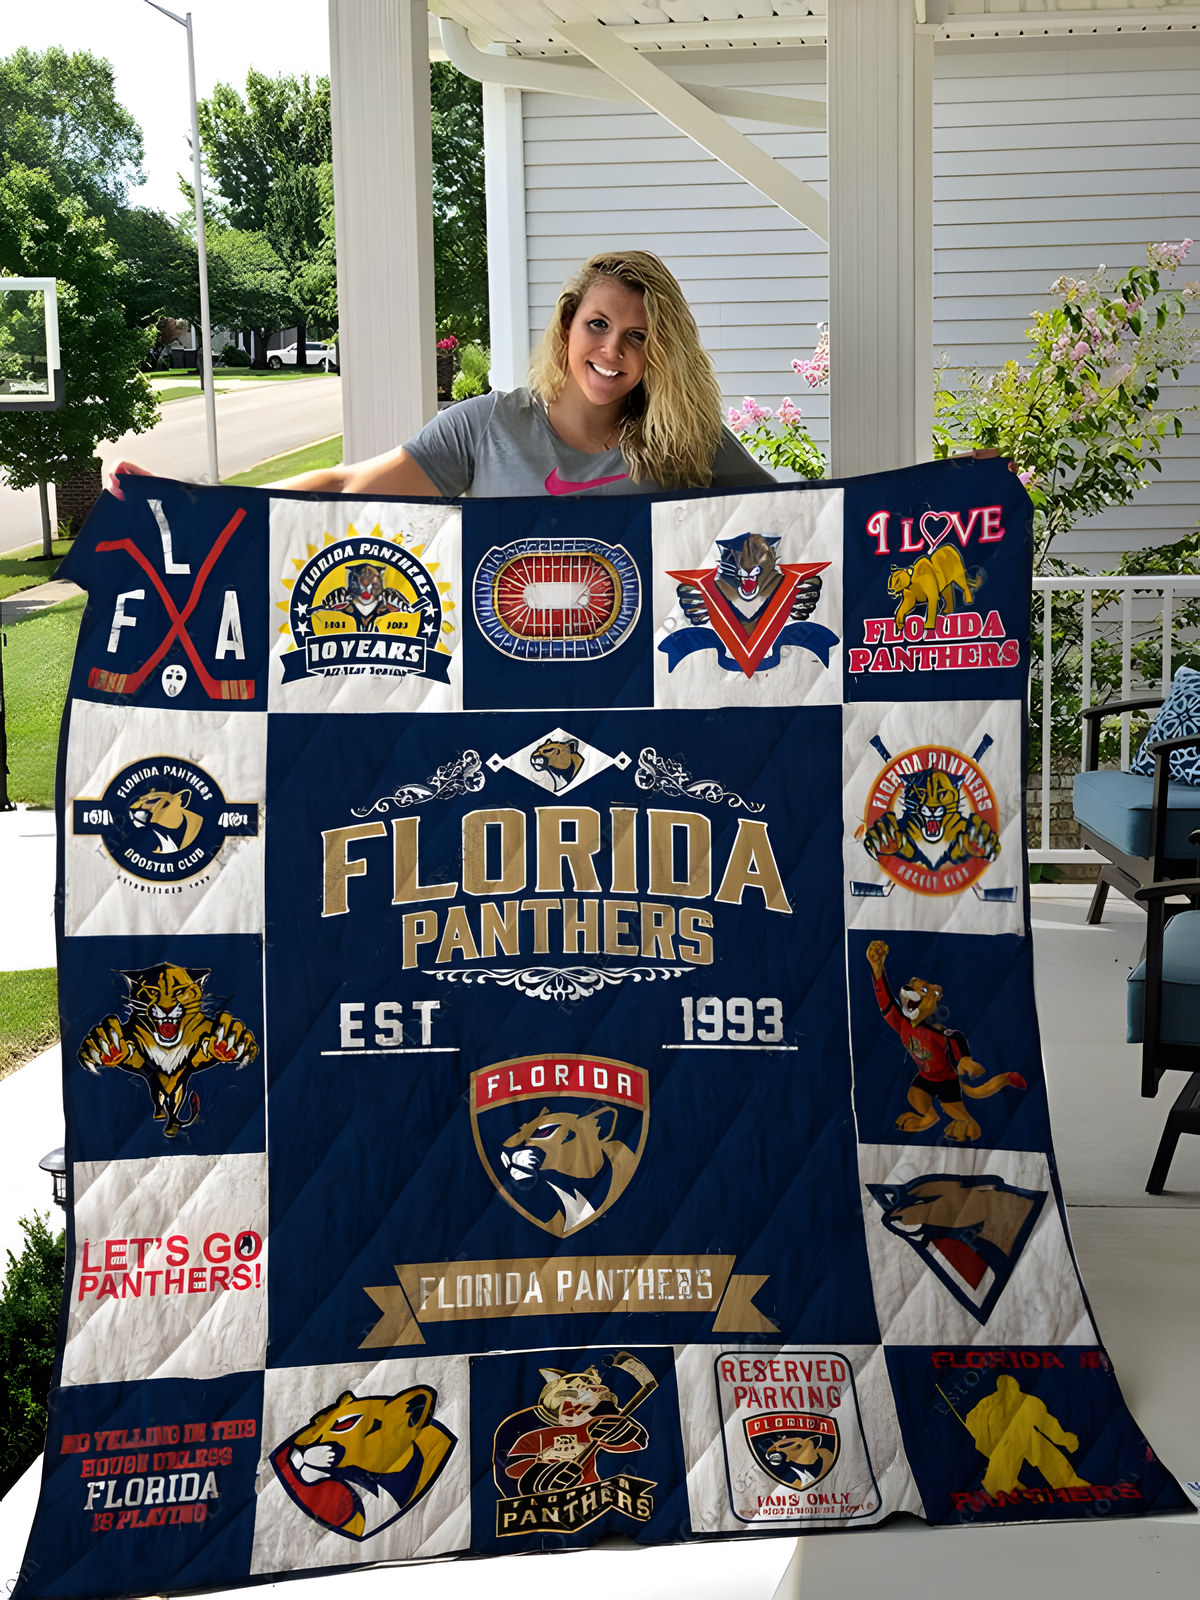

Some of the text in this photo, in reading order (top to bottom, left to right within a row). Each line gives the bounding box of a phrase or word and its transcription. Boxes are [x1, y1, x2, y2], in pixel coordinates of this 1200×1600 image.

[848, 639, 1020, 673] PANTHERS
[320, 805, 793, 918] FLORIDA
[401, 897, 714, 969] PANTHERS
[340, 996, 784, 1048] EST 1993
[487, 1064, 632, 1099] FLORIDA
[81, 1230, 262, 1273] LET'S GO
[78, 1262, 261, 1302] PANTHERS!
[420, 1268, 713, 1311] FLORIDA PANTHERS
[721, 1360, 846, 1383] RESERVED
[733, 1386, 842, 1409] PARKING
[84, 1471, 220, 1510] FLORIDA
